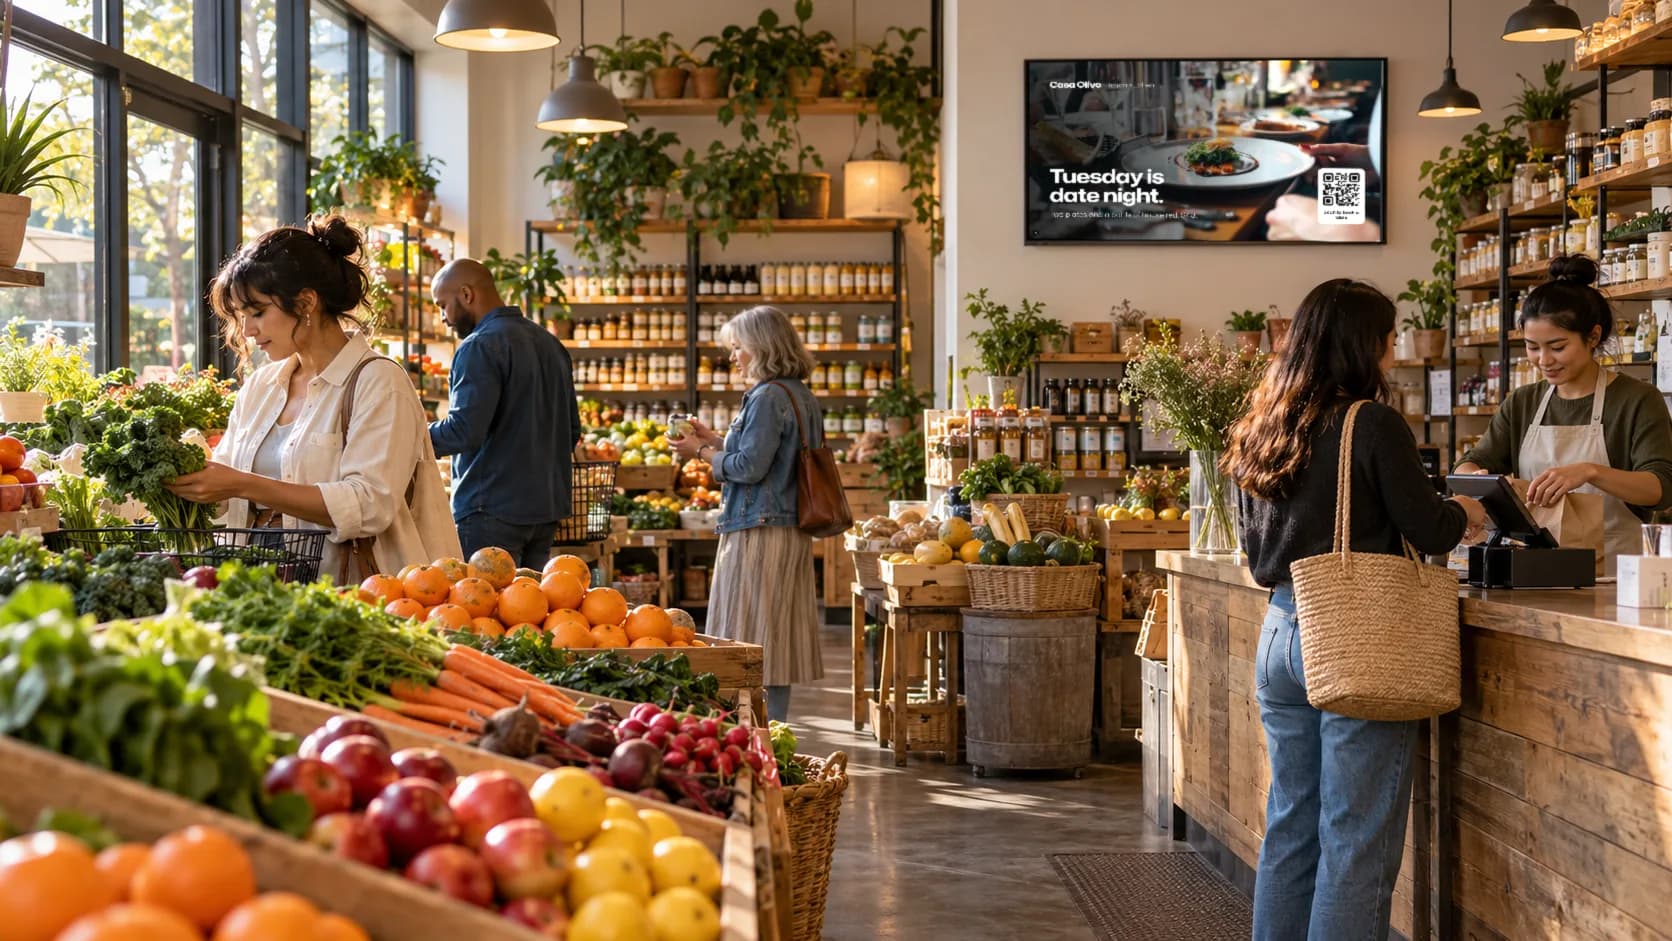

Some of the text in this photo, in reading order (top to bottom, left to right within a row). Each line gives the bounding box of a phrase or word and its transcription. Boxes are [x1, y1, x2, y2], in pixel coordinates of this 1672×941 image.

[1049, 81, 1075, 89] Casa
[1077, 80, 1102, 89] Olivo
[1049, 168, 1165, 188] Tuesday is
[1049, 187, 1164, 207] date night.
